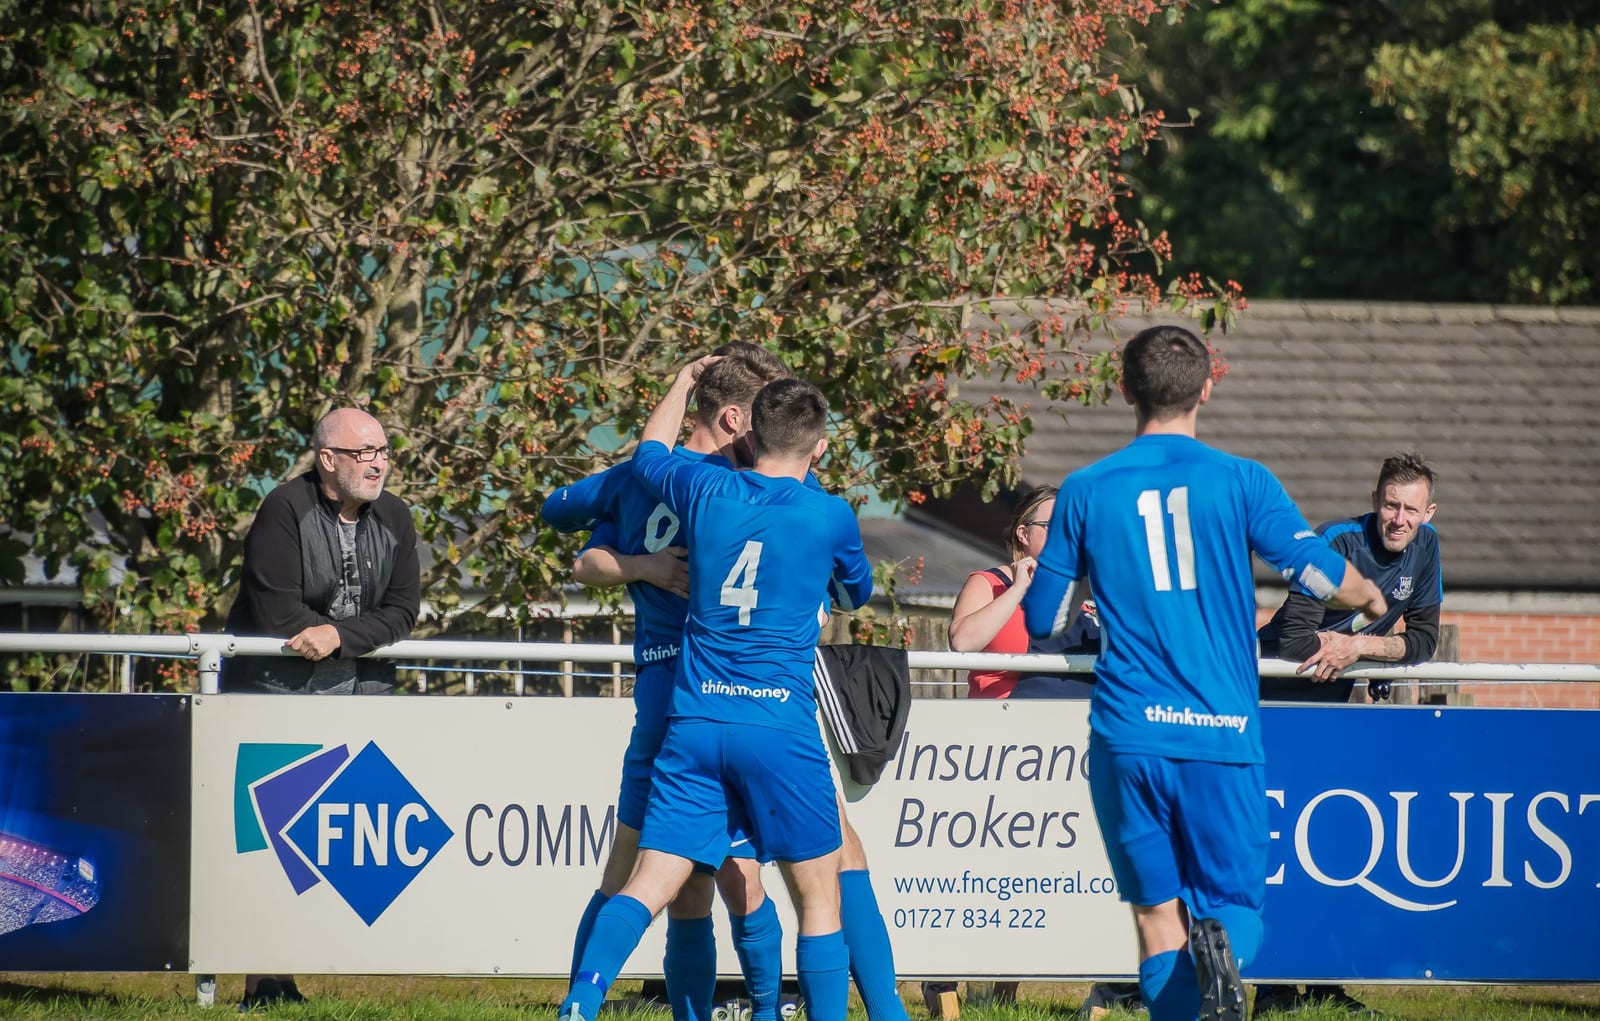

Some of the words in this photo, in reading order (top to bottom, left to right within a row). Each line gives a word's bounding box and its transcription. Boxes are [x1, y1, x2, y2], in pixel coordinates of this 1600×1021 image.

[1137, 486, 1197, 592] 11
[720, 540, 763, 627] 4
[642, 644, 681, 662] think
[701, 680, 791, 703] thinkmoney
[1145, 704, 1249, 734] thinkmoney
[317, 803, 430, 867] FNC
[894, 794, 1080, 849] Brokers
[894, 870, 1121, 901] www.fncgeneral.co
[894, 908, 956, 929] 01727
[962, 908, 1002, 929] 834
[1008, 908, 1047, 929] 222
